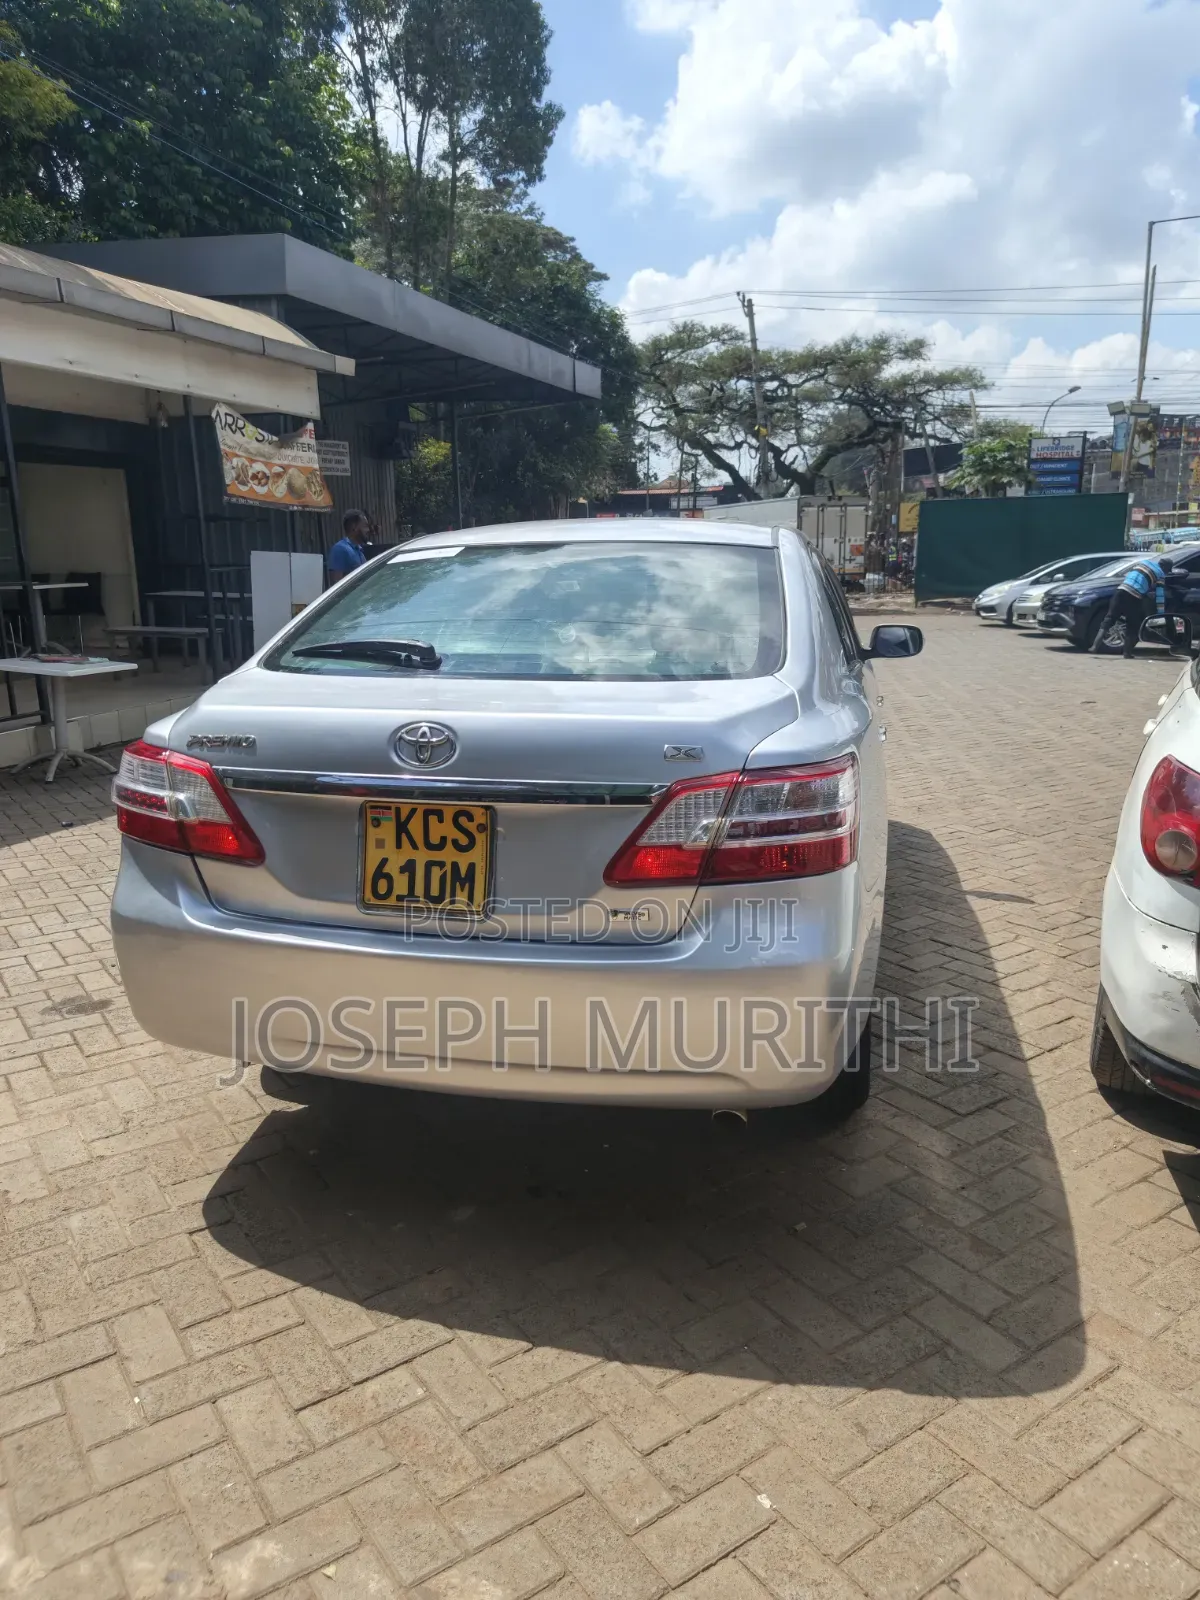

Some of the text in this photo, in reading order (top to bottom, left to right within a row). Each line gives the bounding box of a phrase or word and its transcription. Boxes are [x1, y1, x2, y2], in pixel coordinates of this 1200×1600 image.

[186, 734, 257, 748] PREMIO
[394, 806, 477, 853] KCS
[370, 856, 476, 906] 610M
